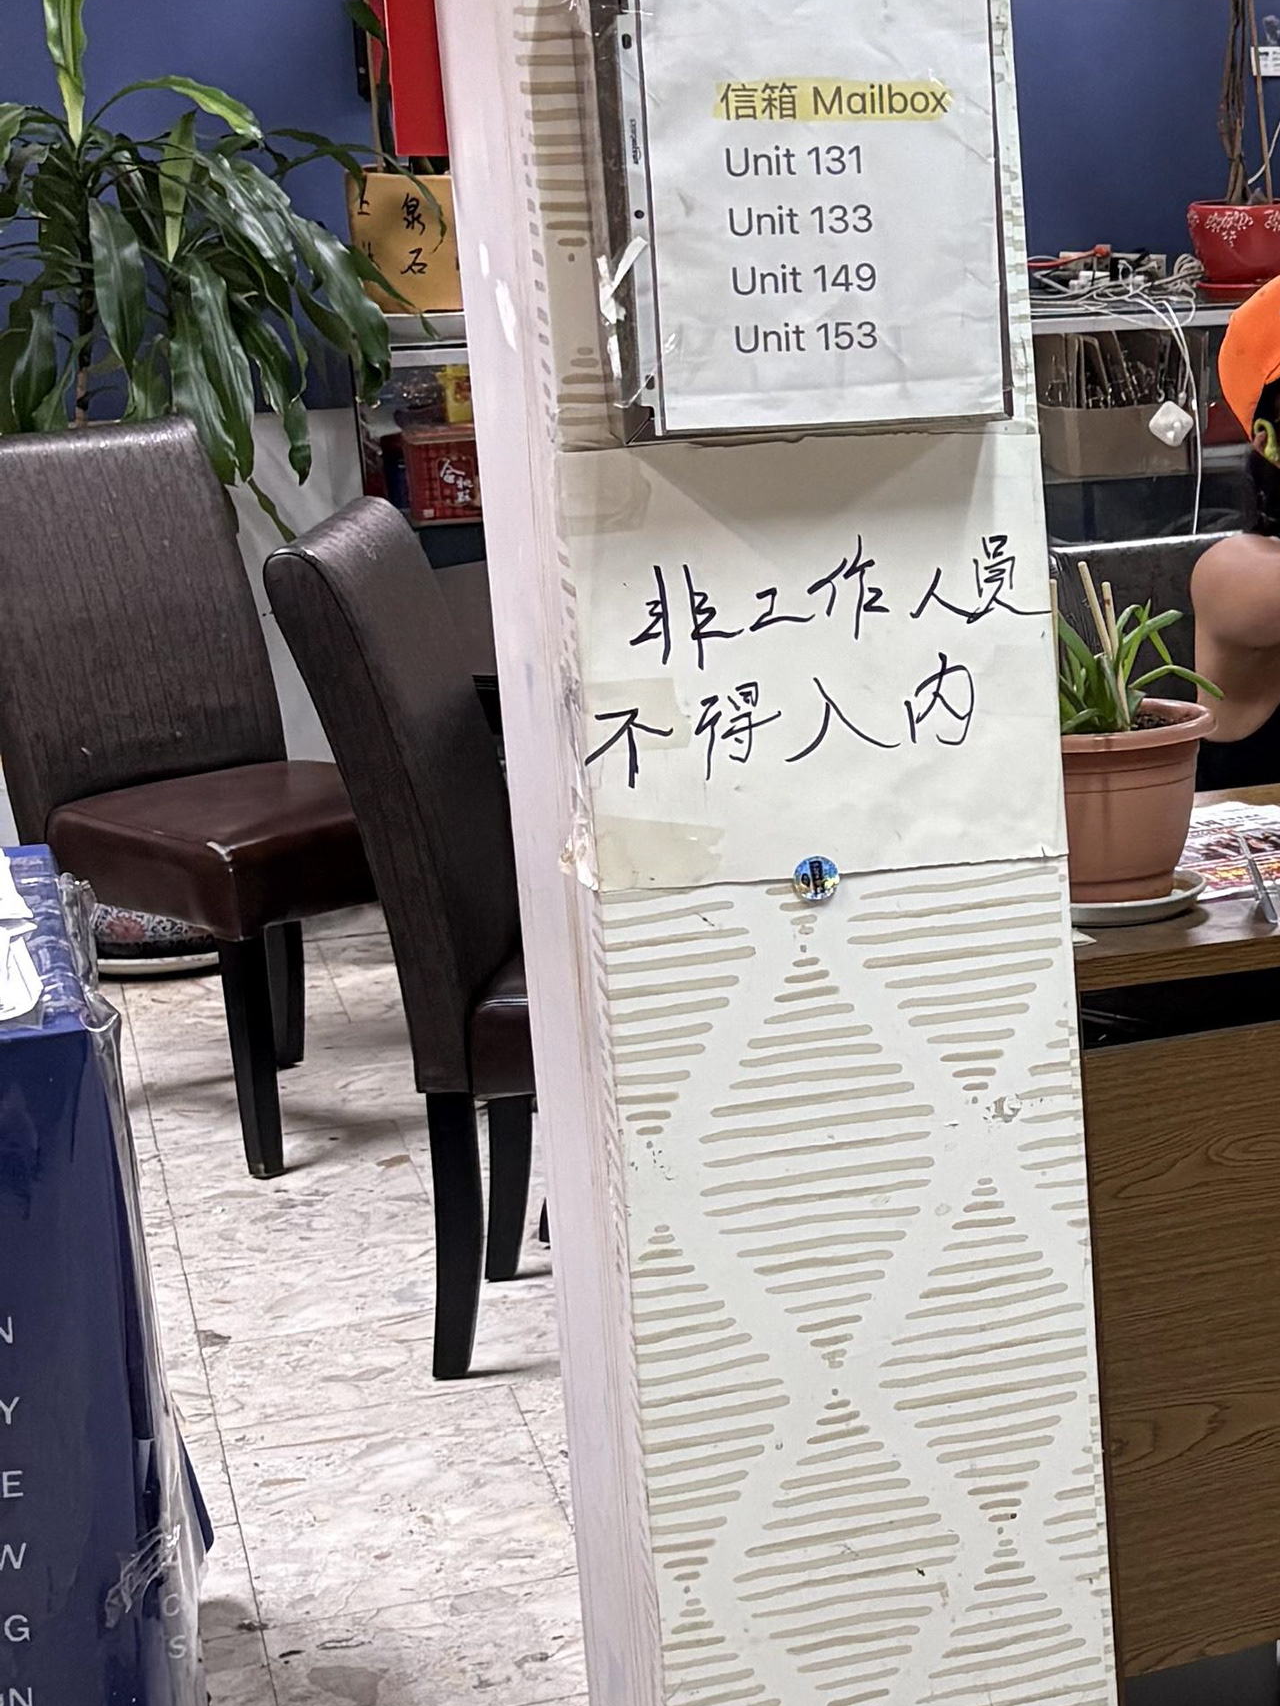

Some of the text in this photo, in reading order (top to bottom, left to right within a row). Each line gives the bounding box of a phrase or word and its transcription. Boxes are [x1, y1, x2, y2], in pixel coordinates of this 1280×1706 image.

[720, 82, 949, 121] 信箱 Mailbox
[725, 145, 863, 178] Unit 131
[728, 204, 873, 236] Unit 133
[732, 263, 877, 295] Unit 149
[734, 322, 878, 353] Unit 153
